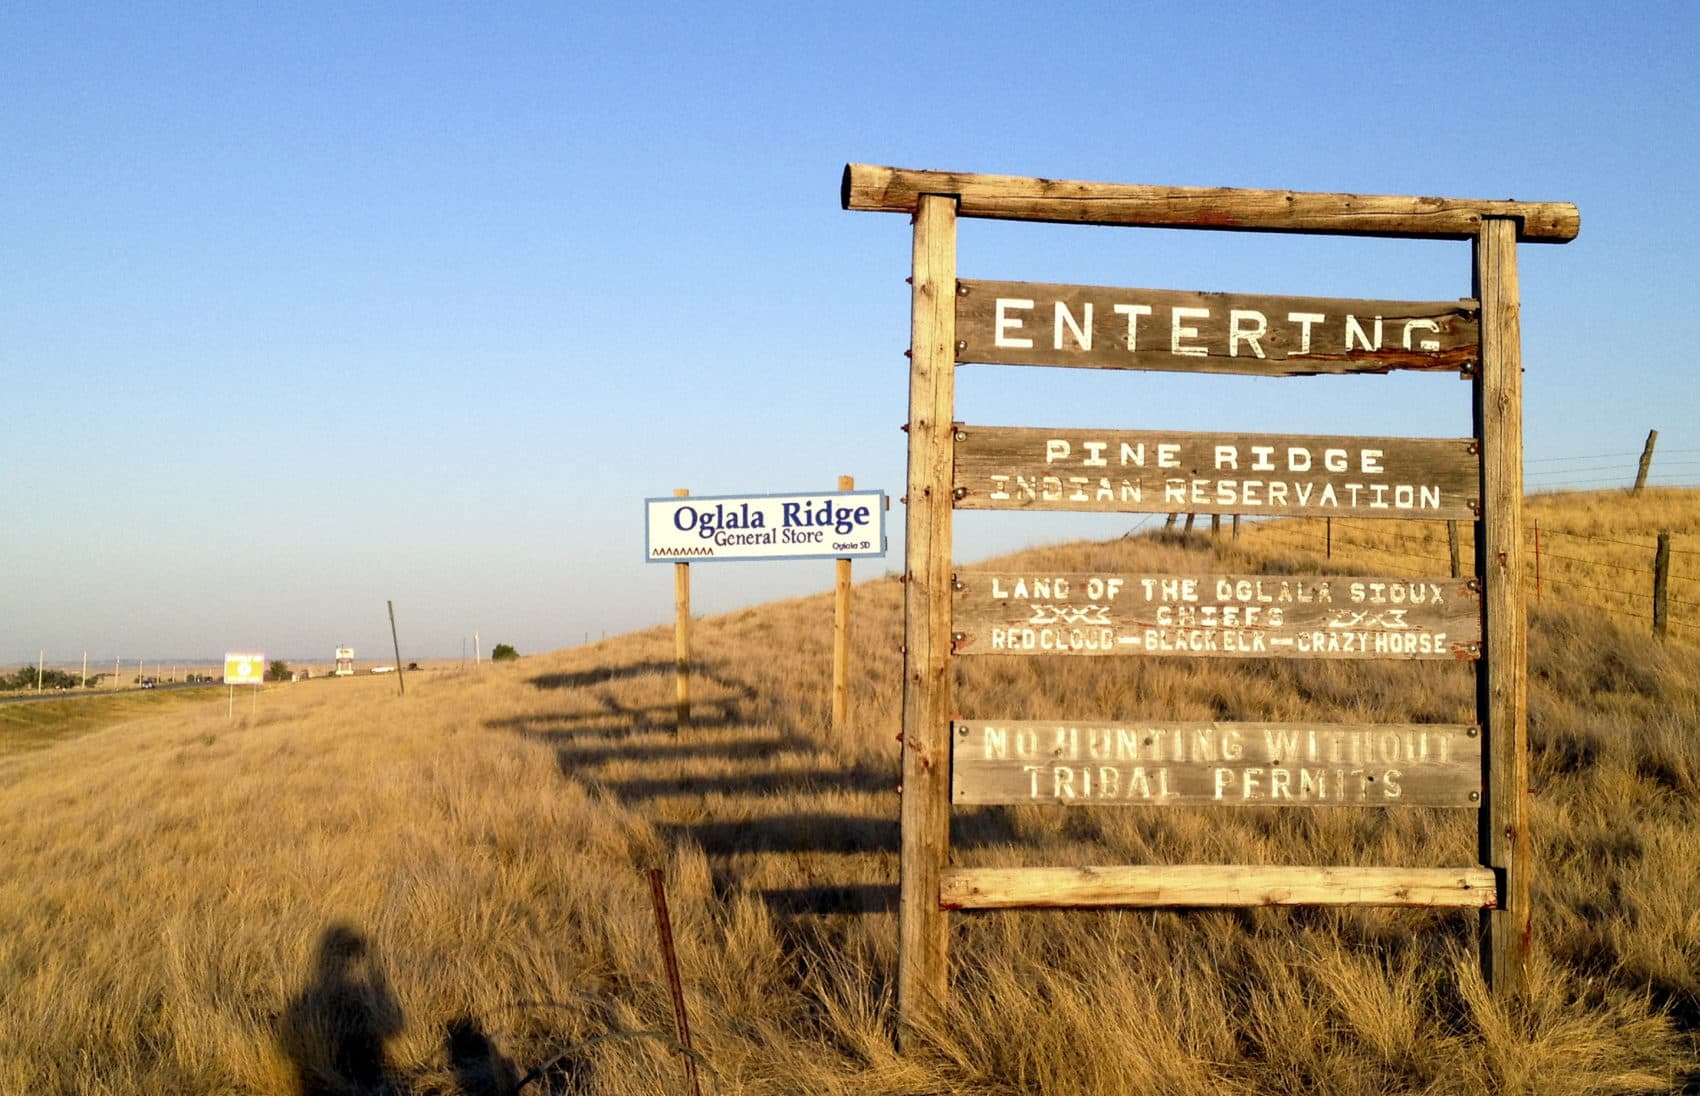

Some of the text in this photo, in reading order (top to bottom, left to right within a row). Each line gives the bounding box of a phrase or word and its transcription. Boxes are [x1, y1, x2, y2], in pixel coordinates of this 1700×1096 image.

[994, 298, 1441, 358] ENTERING
[1046, 439, 1384, 473] PINE RIDGE
[989, 474, 1441, 508] INDIAN RESERVATION
[674, 500, 870, 539] Oglala Ridge
[714, 528, 824, 546] General Store
[992, 577, 1070, 600] LAND
[1087, 578, 1124, 600] OF
[1141, 578, 1199, 602] THE
[1350, 582, 1445, 605] SIOUX
[1156, 606, 1284, 627] CHIEFS
[983, 726, 1037, 760] NO
[1263, 730, 1453, 764] WITHOUT
[1024, 766, 1402, 801] TRIBAL PERMITS
